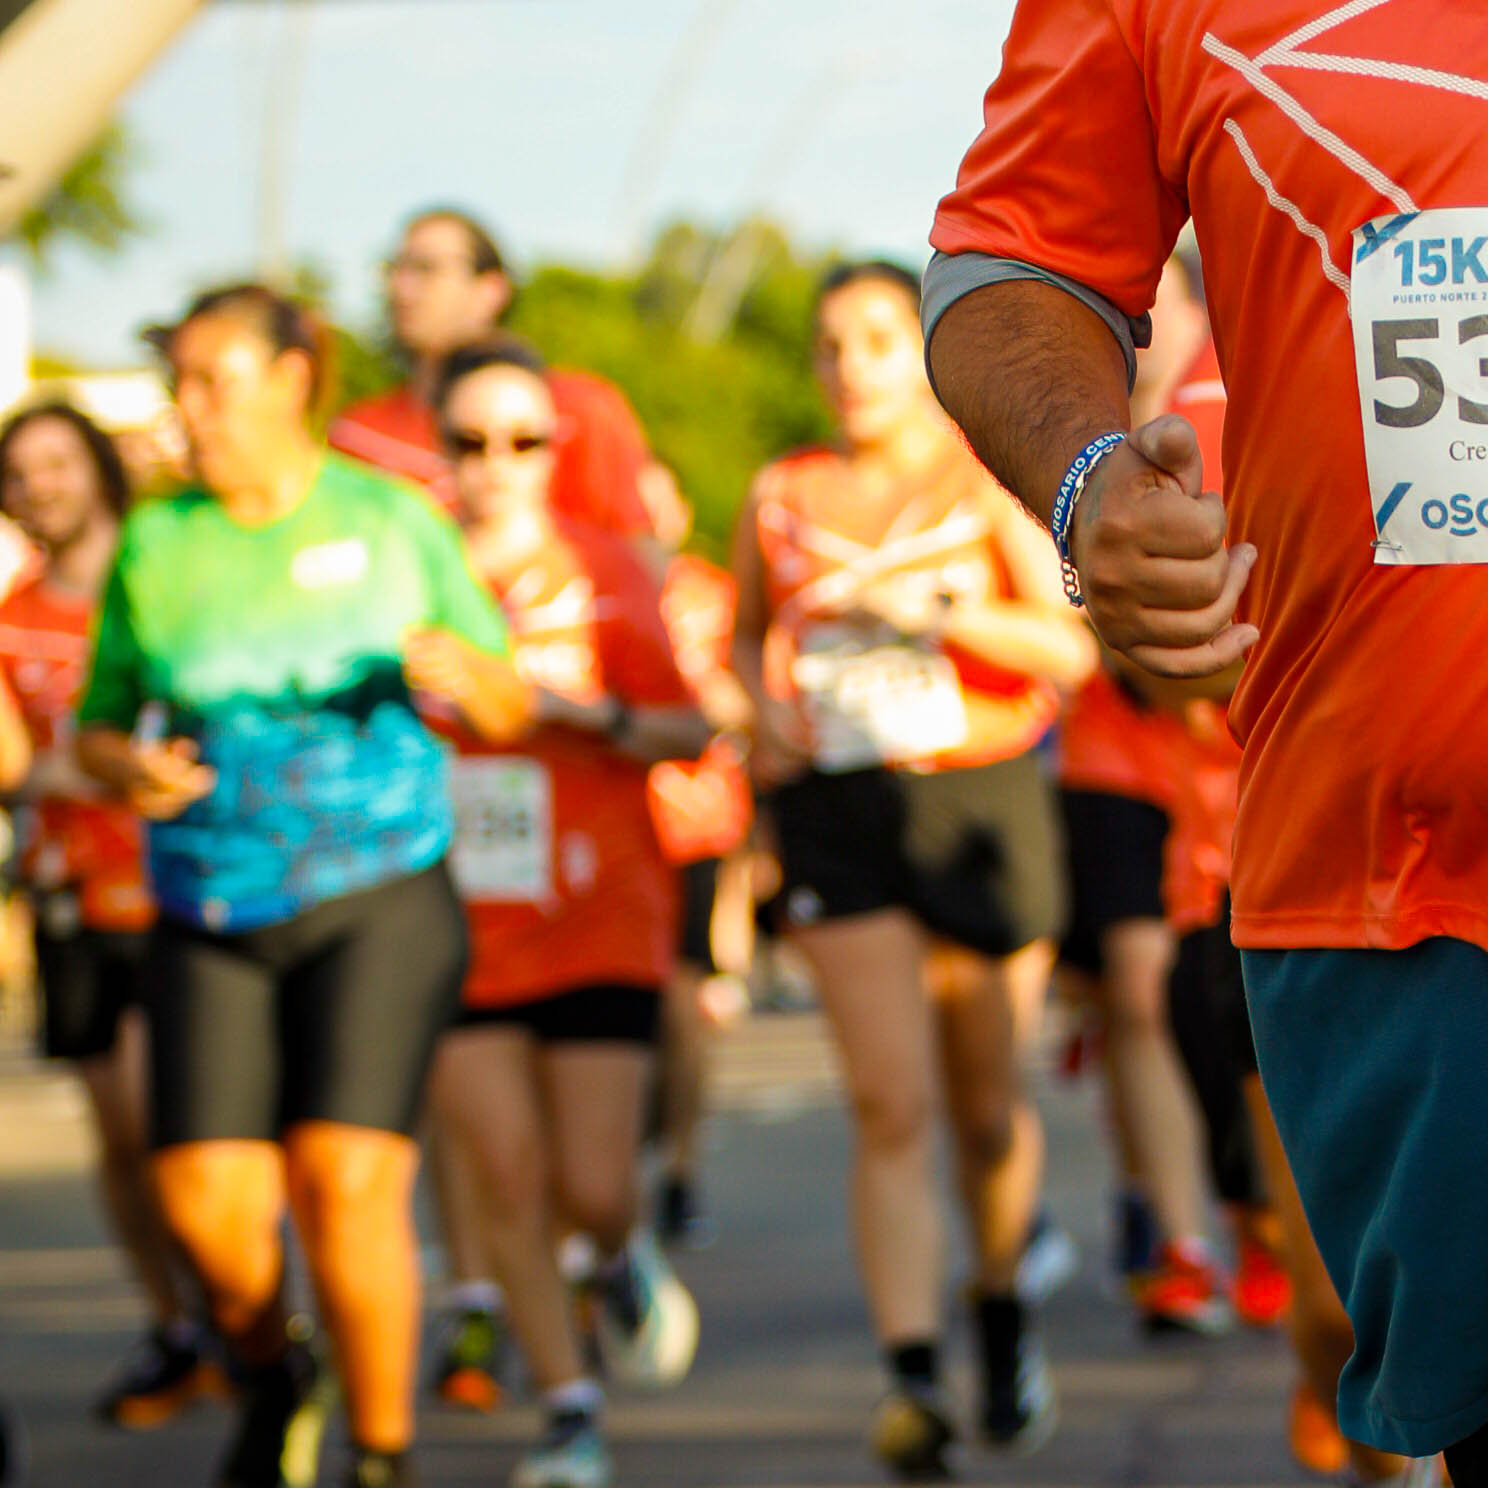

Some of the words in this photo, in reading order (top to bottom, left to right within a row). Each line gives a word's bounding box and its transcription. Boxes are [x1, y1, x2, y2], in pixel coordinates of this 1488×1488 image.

[1392, 293, 1436, 304] PUERTO
[1440, 291, 1477, 302] NORTE
[1052, 457, 1086, 532] ROSARIO
